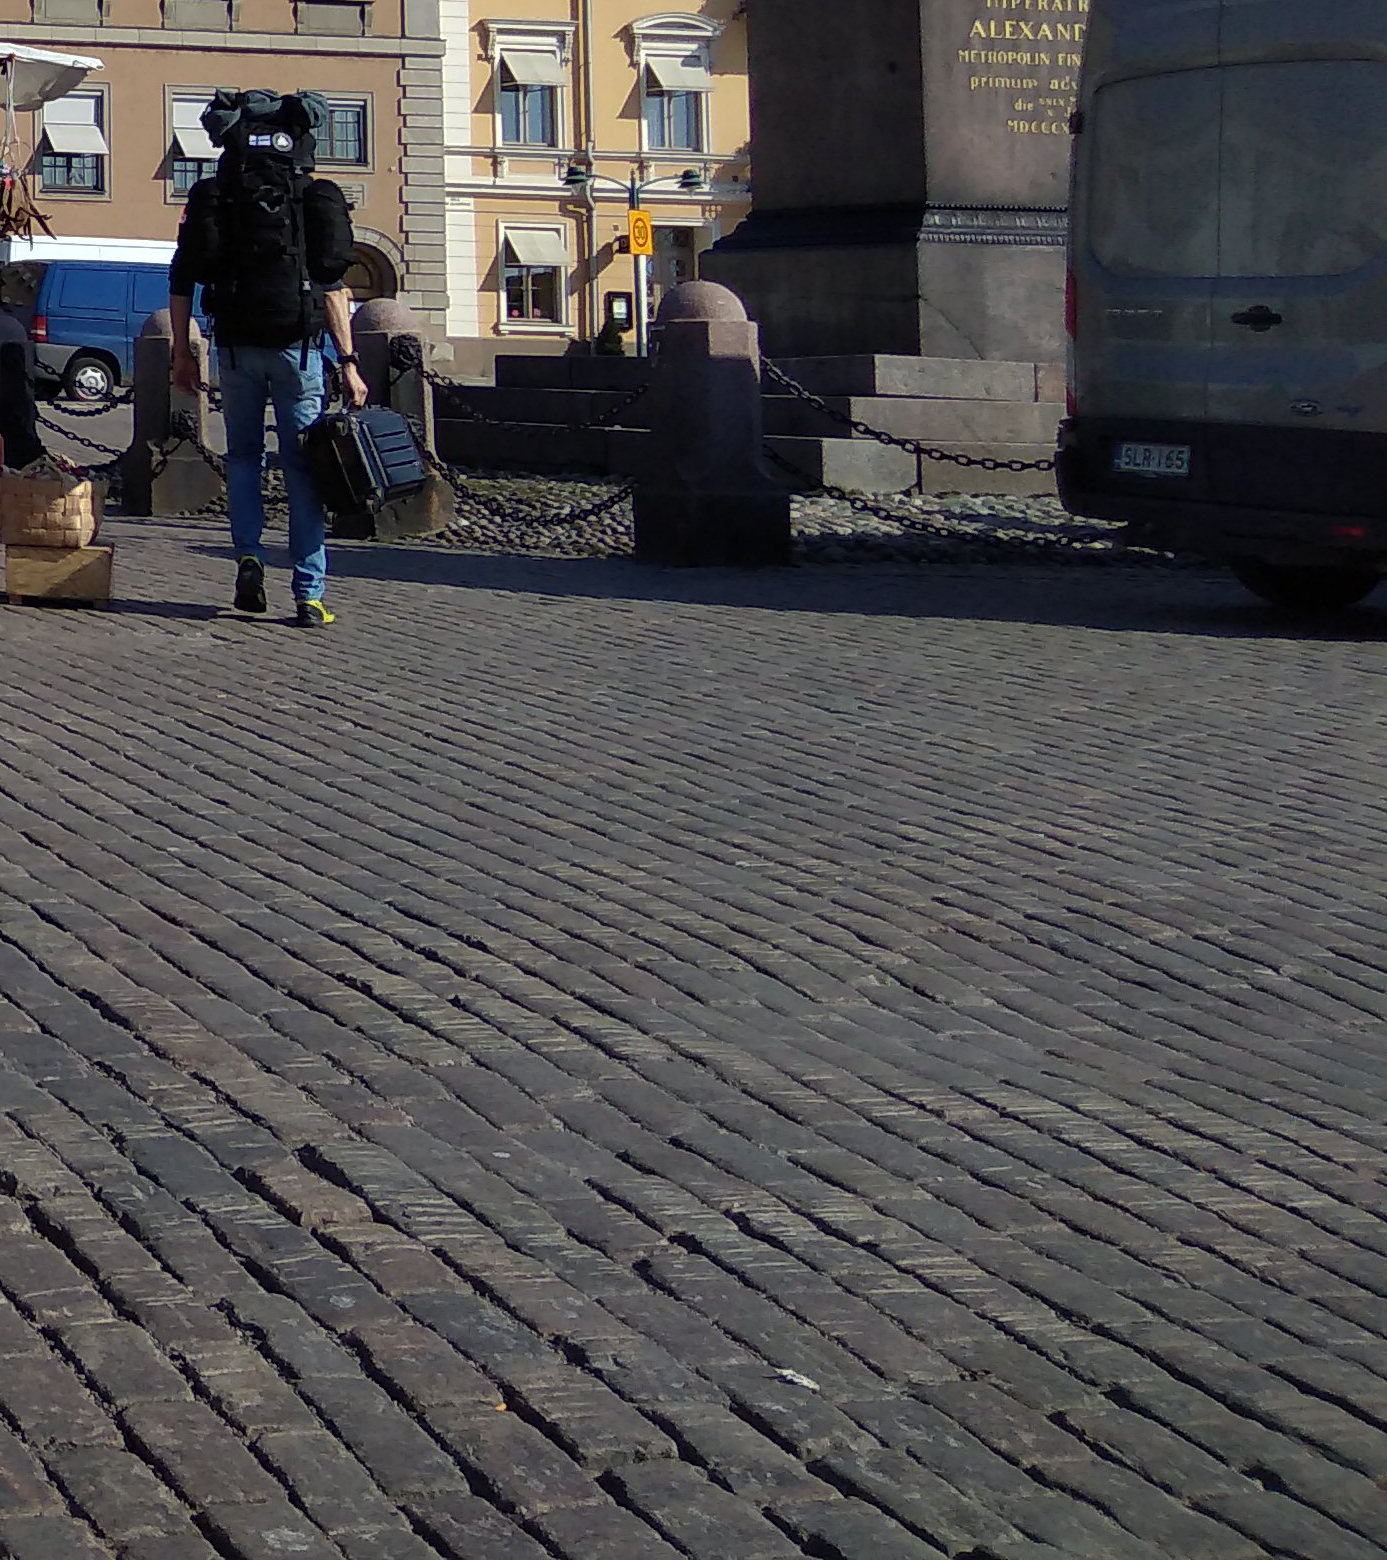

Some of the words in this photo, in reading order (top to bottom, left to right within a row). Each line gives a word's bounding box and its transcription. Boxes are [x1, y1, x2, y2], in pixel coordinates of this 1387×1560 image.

[958, 49, 1050, 65] METROPOLIN
[970, 75, 1038, 90] primum
[1014, 98, 1034, 111] die
